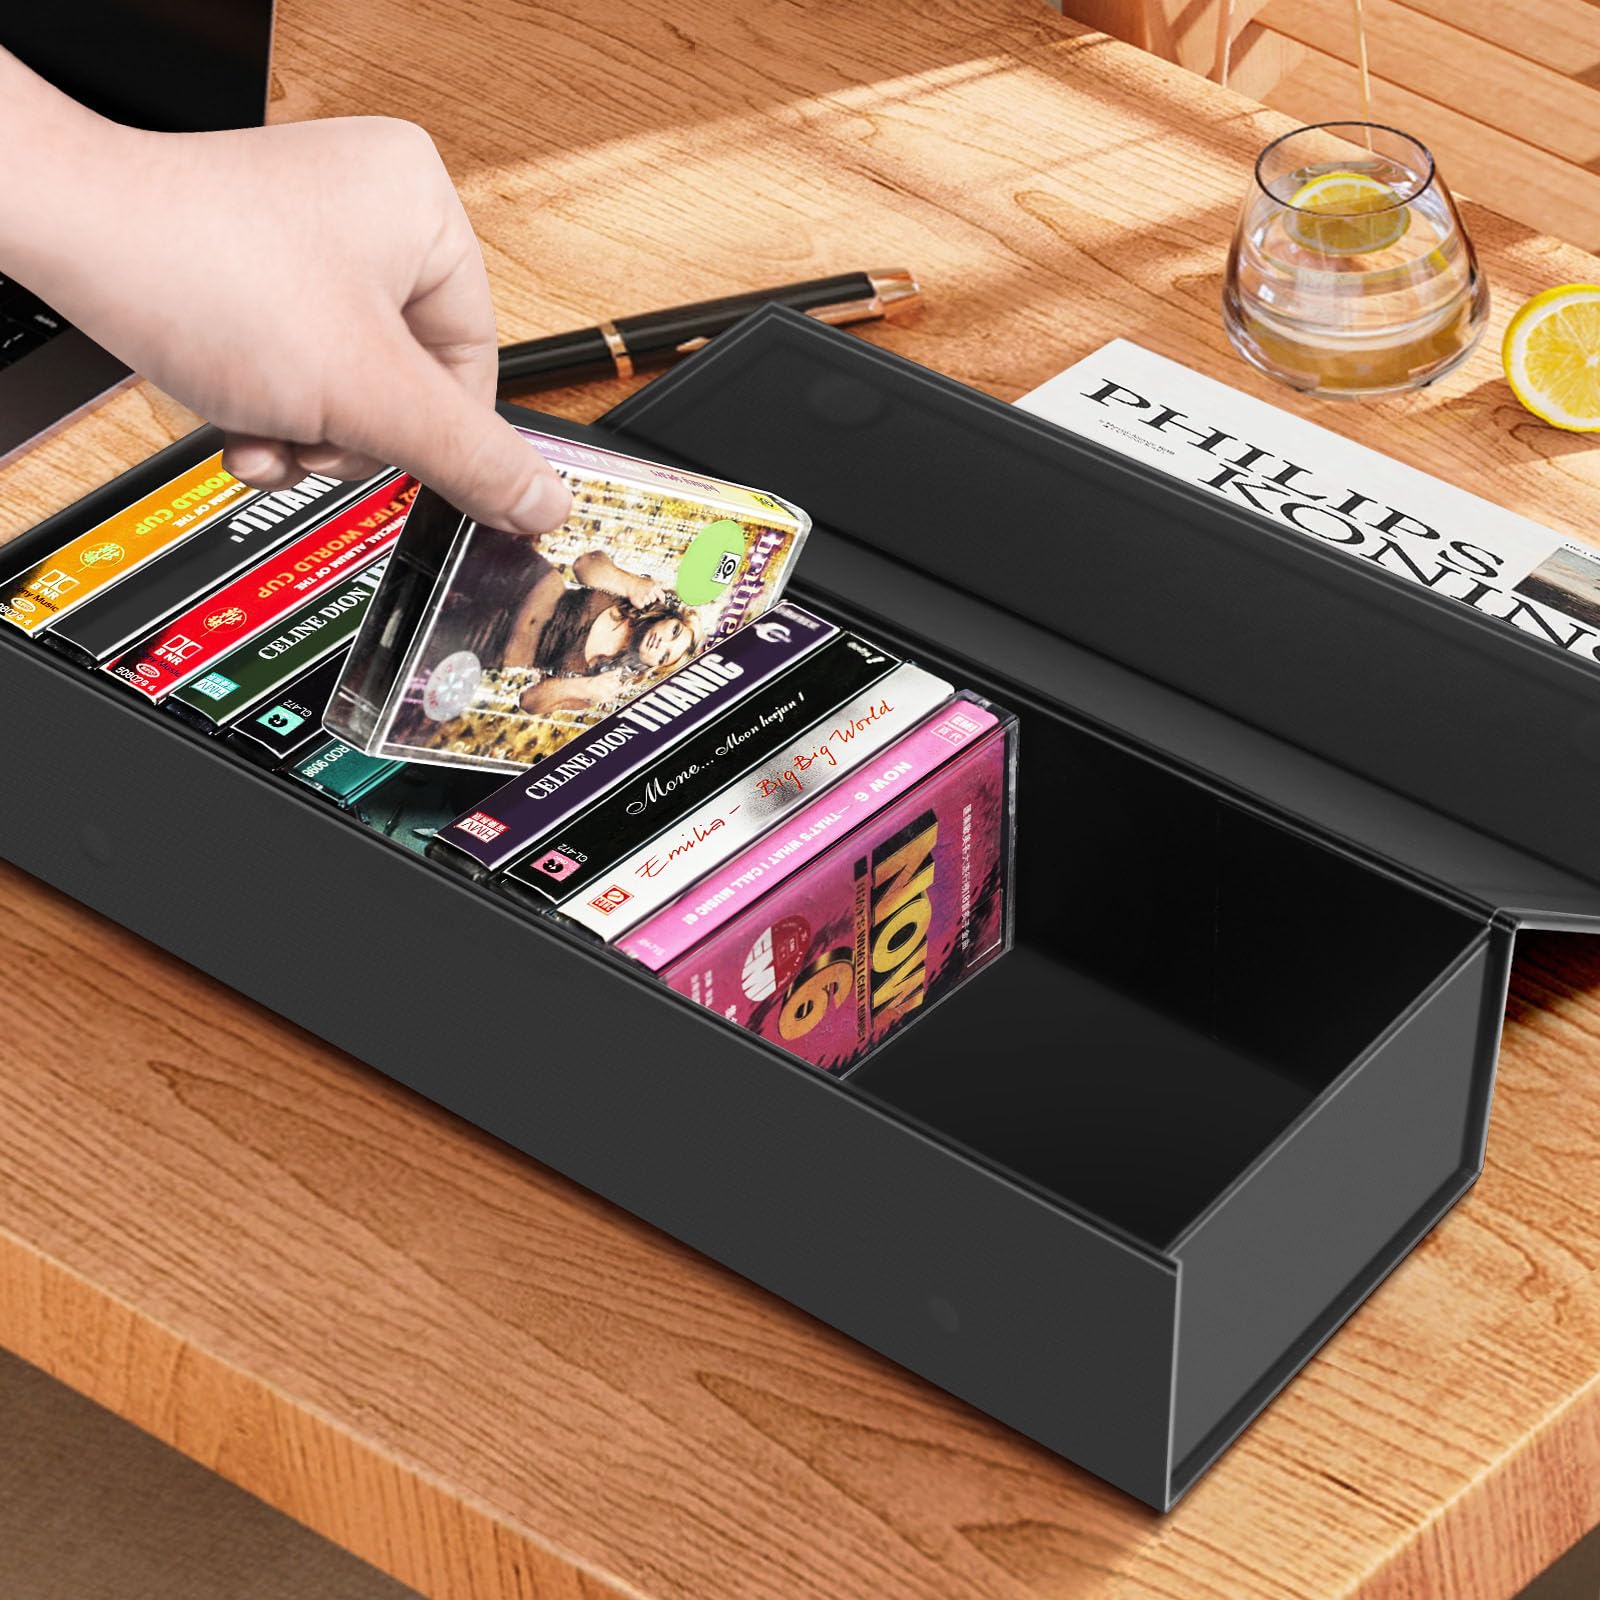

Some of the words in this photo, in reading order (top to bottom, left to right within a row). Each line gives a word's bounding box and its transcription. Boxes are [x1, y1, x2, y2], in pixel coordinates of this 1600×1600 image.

[1080, 378, 1505, 580] PHILIPS
[135, 508, 174, 535] CUP
[358, 501, 406, 528] FIFA
[293, 529, 364, 572] WORLD
[329, 542, 367, 569] ALBUM
[1198, 462, 1600, 664] KONIN
[257, 572, 296, 599] CUP
[294, 576, 317, 591] THE
[315, 566, 331, 579] OF
[33, 595, 59, 612] Music
[40, 587, 60, 600] NR
[258, 615, 328, 660] CELINE
[319, 587, 372, 619] DION
[154, 647, 166, 656] B
[164, 652, 183, 666] NR
[196, 681, 227, 698] HMV
[283, 699, 312, 717] CL-472
[525, 752, 597, 800] CELINE
[587, 723, 640, 758] DION
[617, 653, 744, 732] TITANIC
[715, 724, 760, 756] Moon
[324, 744, 350, 762] ROD
[302, 759, 329, 777] 9098
[869, 761, 913, 793] NOW
[635, 818, 726, 878] Emilia
[756, 768, 804, 798] Big
[794, 745, 837, 771] Big
[829, 700, 894, 743] World
[854, 792, 870, 803] 6
[461, 820, 497, 841] HMV
[557, 843, 588, 863] CL-472
[763, 861, 771, 870] I
[769, 838, 801, 866] WHAT
[731, 866, 764, 888] CALL
[695, 888, 735, 915] MUSIC
[871, 808, 939, 1029] NOW
[741, 926, 777, 1002] EMI
[778, 950, 855, 1041] 6
